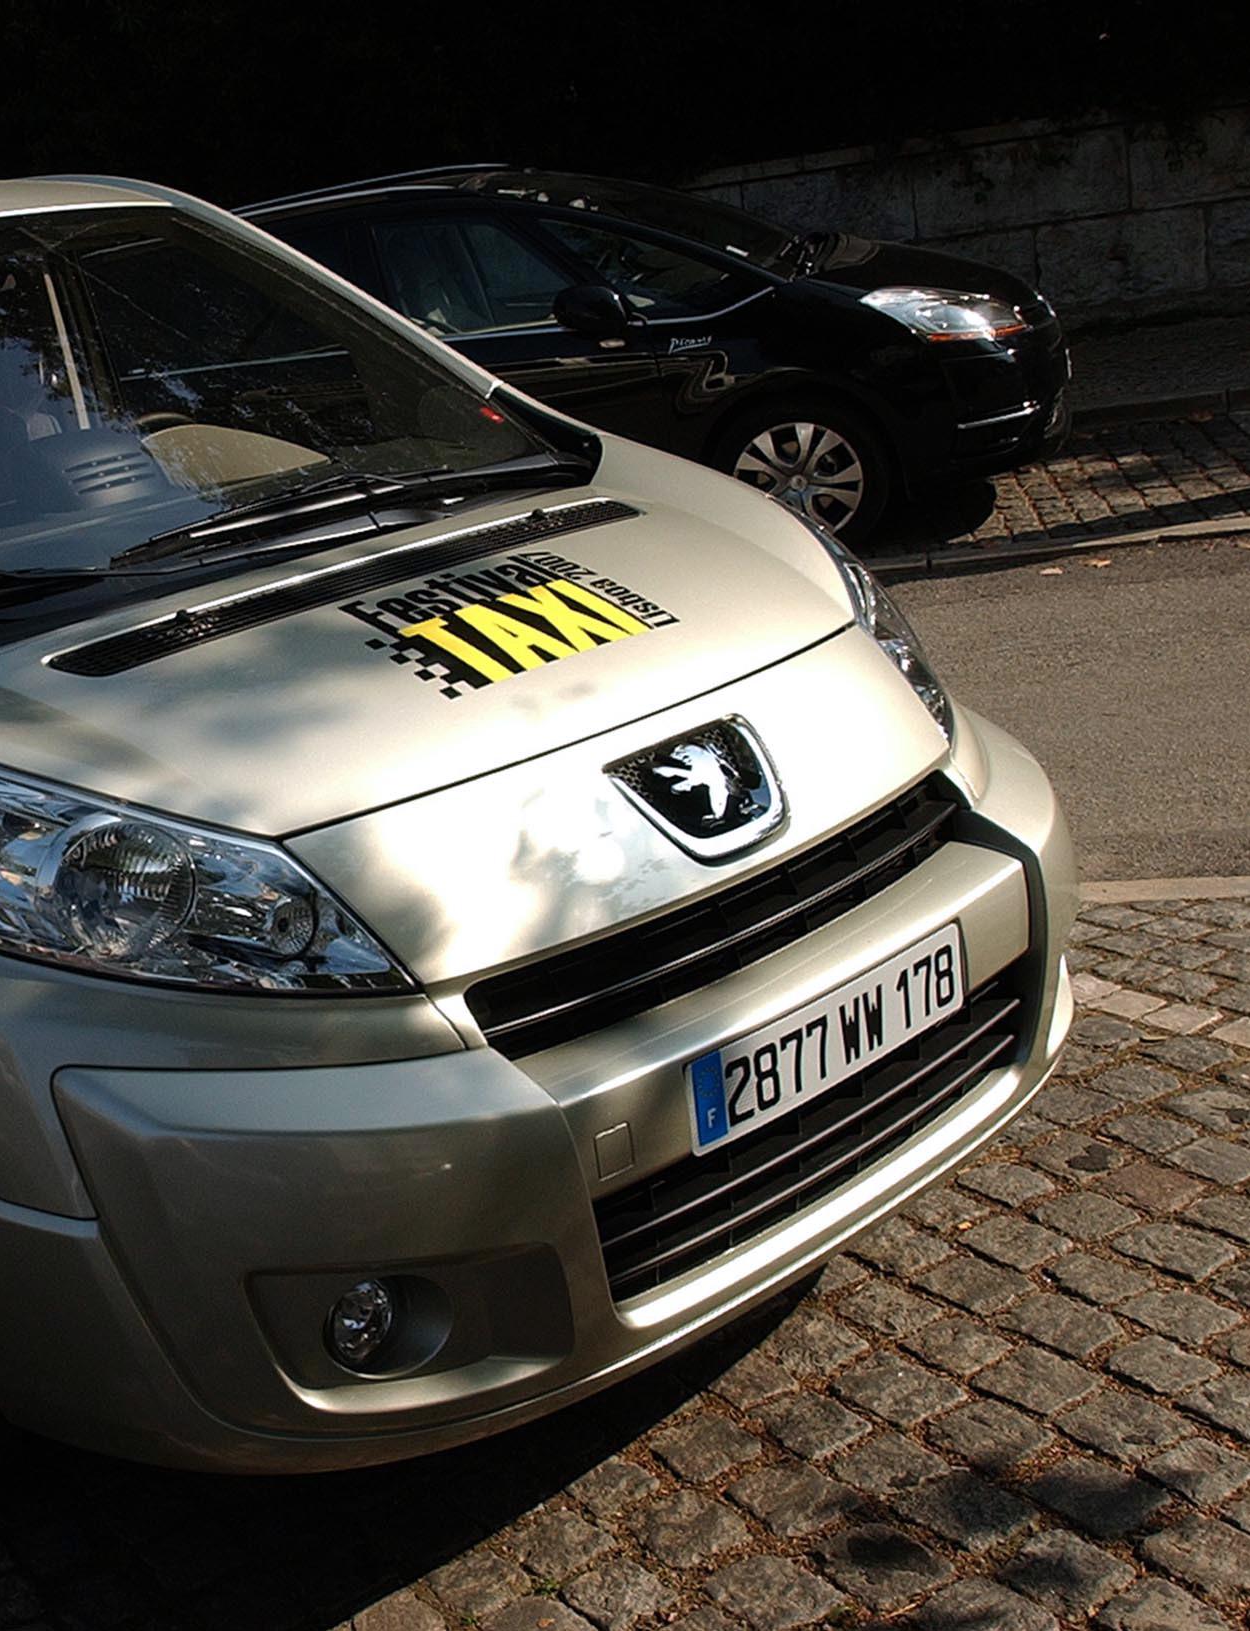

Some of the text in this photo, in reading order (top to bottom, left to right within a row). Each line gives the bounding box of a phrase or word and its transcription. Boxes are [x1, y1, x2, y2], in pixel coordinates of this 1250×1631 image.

[338, 556, 562, 641] Festival
[399, 579, 653, 683] TAXI
[517, 551, 680, 628] Lisboa 2007
[724, 943, 955, 1127] 2877 WW 178
[706, 1107, 717, 1129] F
